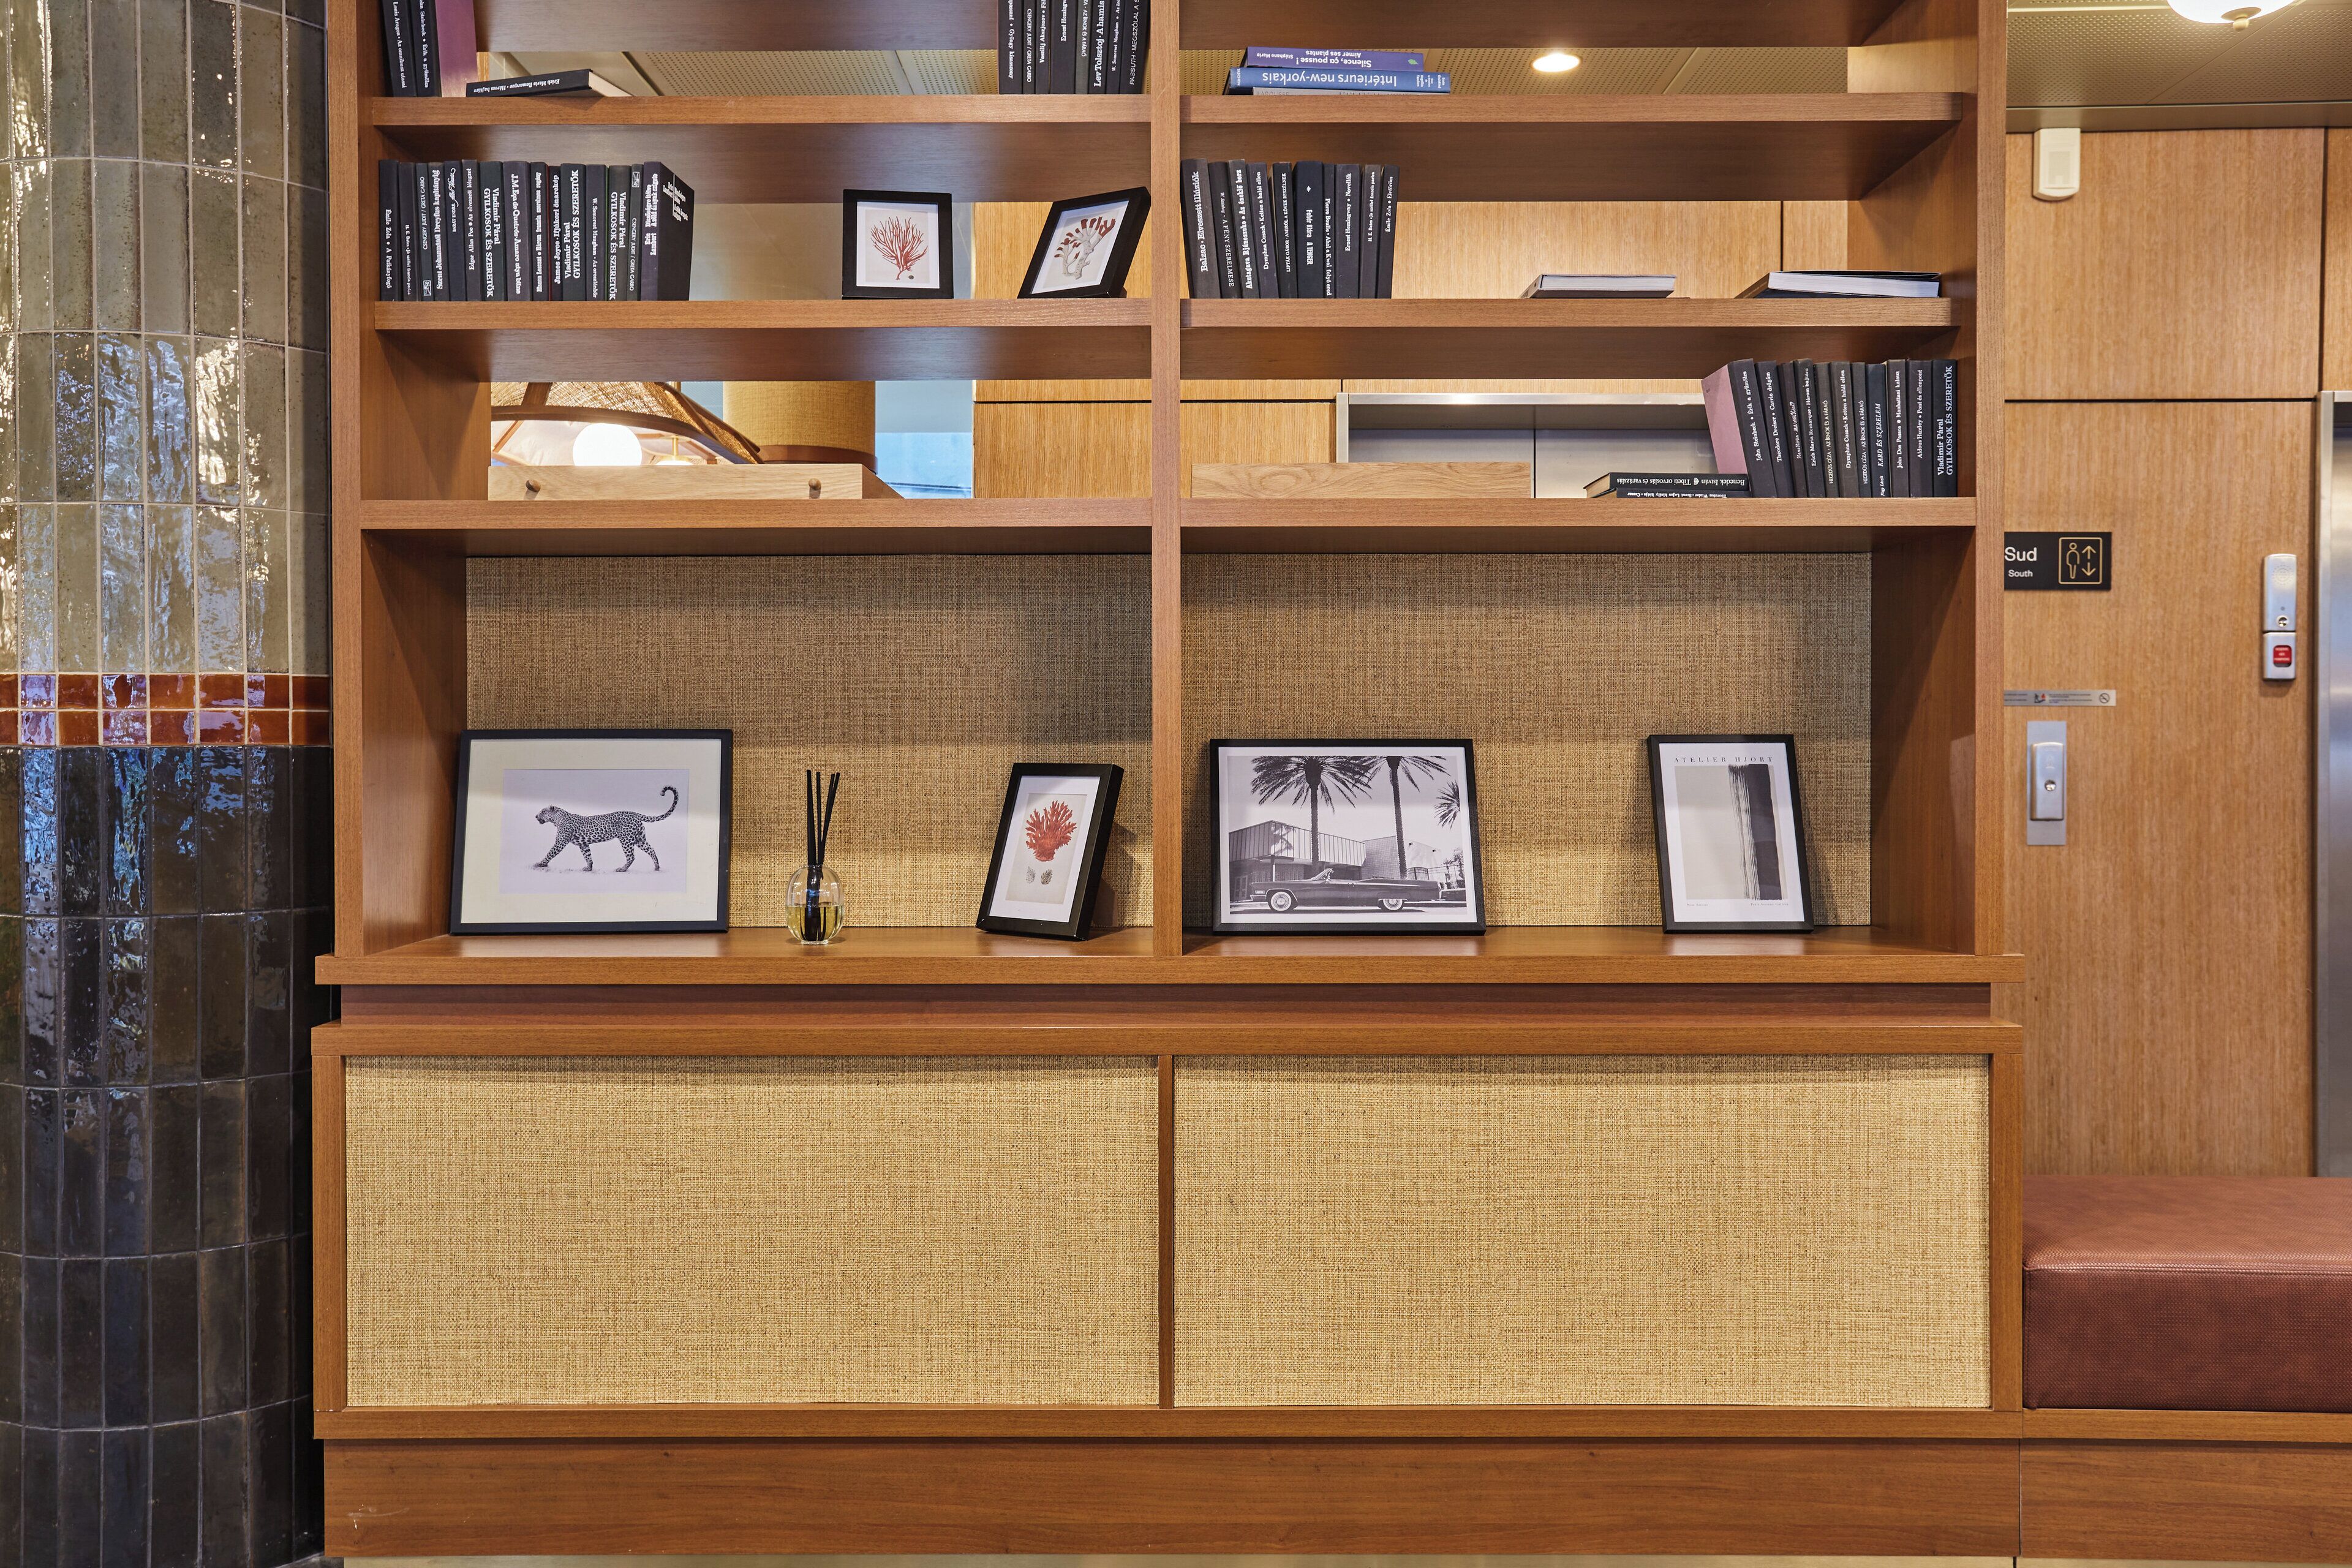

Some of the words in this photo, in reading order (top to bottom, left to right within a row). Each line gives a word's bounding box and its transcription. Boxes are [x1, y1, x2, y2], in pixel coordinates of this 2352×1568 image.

[1096, 0, 1105, 27] hamis
[1094, 38, 1105, 71] Tolsztoj
[1340, 57, 1371, 68] Silence,
[1093, 70, 1102, 87] Lev
[1262, 70, 1335, 85] new-yorkais
[1337, 74, 1396, 87] Intérieurs
[570, 168, 579, 215] SZERETŐK
[1191, 170, 1201, 203] illúziók
[432, 205, 442, 233] Dreyfus
[467, 213, 473, 221] Az
[483, 187, 492, 238] GYILKOSOK
[570, 216, 579, 228] ÉS
[1194, 202, 1205, 240] Elveszett
[484, 238, 493, 251] ÉS
[572, 228, 581, 279] GYILKOSOK
[609, 241, 618, 254] ÉS
[1199, 243, 1208, 272] Balzac
[485, 251, 494, 298] SZERETŐK
[592, 259, 598, 268] Az
[608, 254, 617, 300] SZERETŐK
[1224, 244, 1234, 287] SZERELMESE
[1943, 365, 1953, 411] SZERETŐK
[1874, 402, 1883, 438] SZERELEM
[1943, 413, 1953, 424] ÉS
[1749, 421, 1759, 447] Steinbeck
[1875, 439, 1883, 447] ÉS
[2004, 546, 2037, 562] Sud
